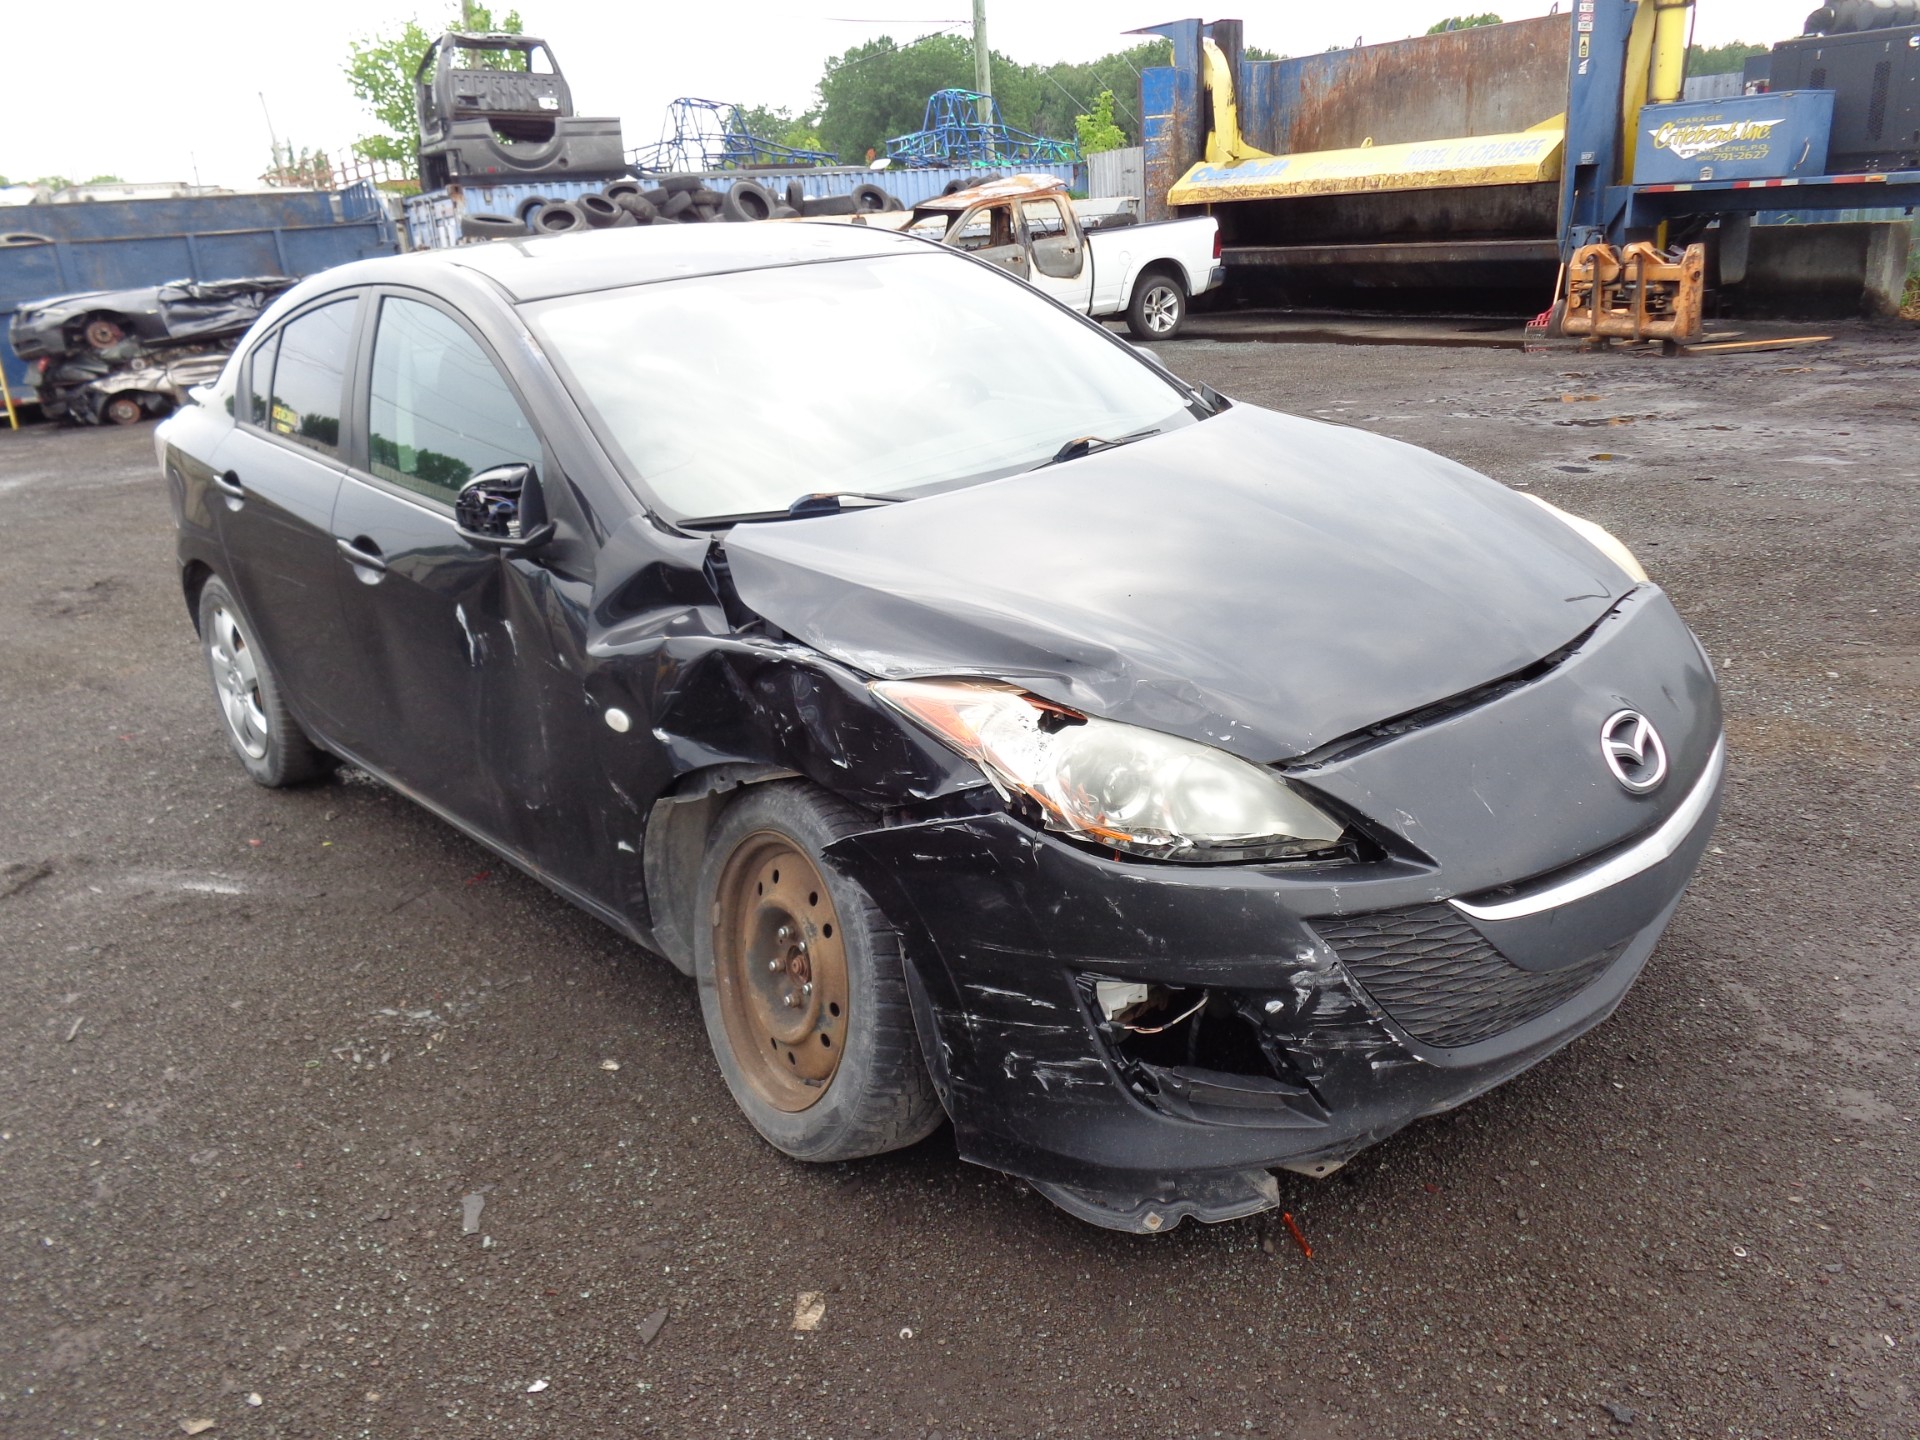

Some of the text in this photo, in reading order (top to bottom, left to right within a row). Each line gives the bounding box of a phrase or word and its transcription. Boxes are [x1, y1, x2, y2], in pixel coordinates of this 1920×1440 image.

[1677, 114, 1723, 124] GARAGE
[1471, 138, 1546, 161] CRUSHER
[1713, 149, 1769, 162] 791-2627
